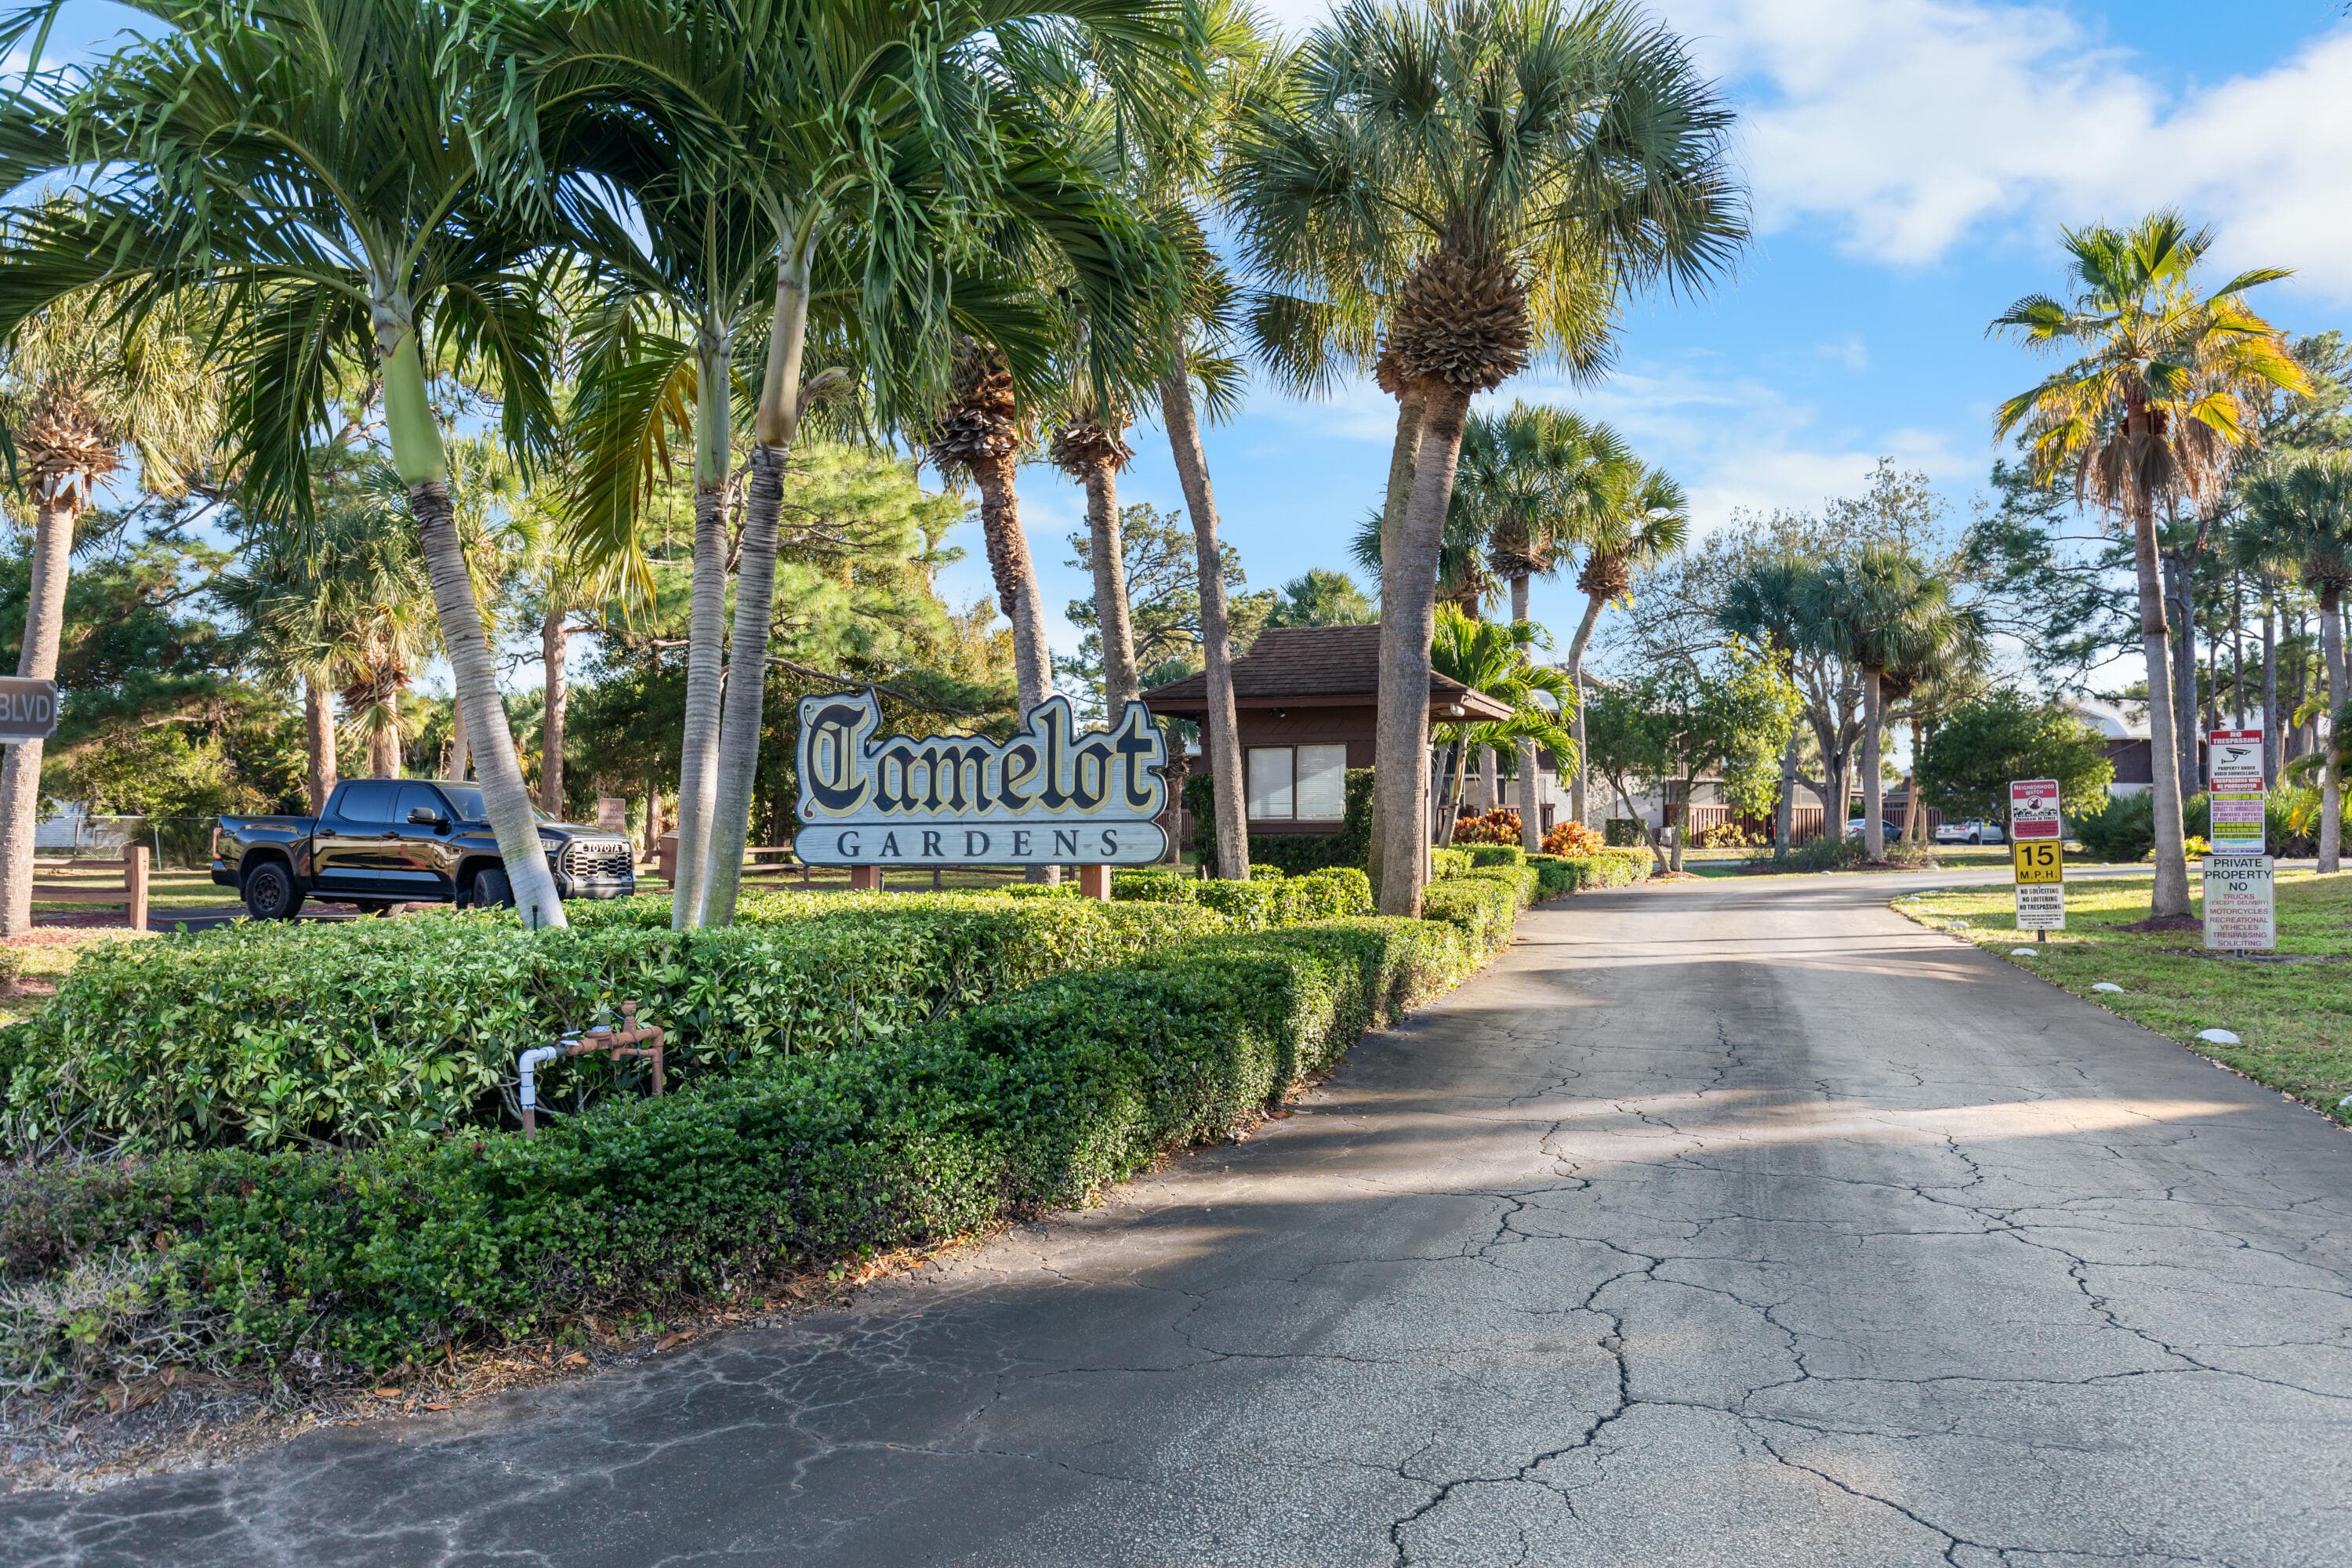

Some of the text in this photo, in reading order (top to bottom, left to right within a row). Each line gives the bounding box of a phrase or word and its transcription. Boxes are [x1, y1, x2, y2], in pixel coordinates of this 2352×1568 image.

[0, 693, 50, 722] BLVD
[804, 703, 1154, 818] Camelot
[837, 829, 1118, 857] GARDENS
[2021, 845, 2054, 866] 15
[2214, 858, 2263, 867] PRIVATE
[2020, 870, 2057, 879] M.P.H.
[2205, 870, 2271, 879] PROPERTY
[2229, 882, 2248, 891] NO
